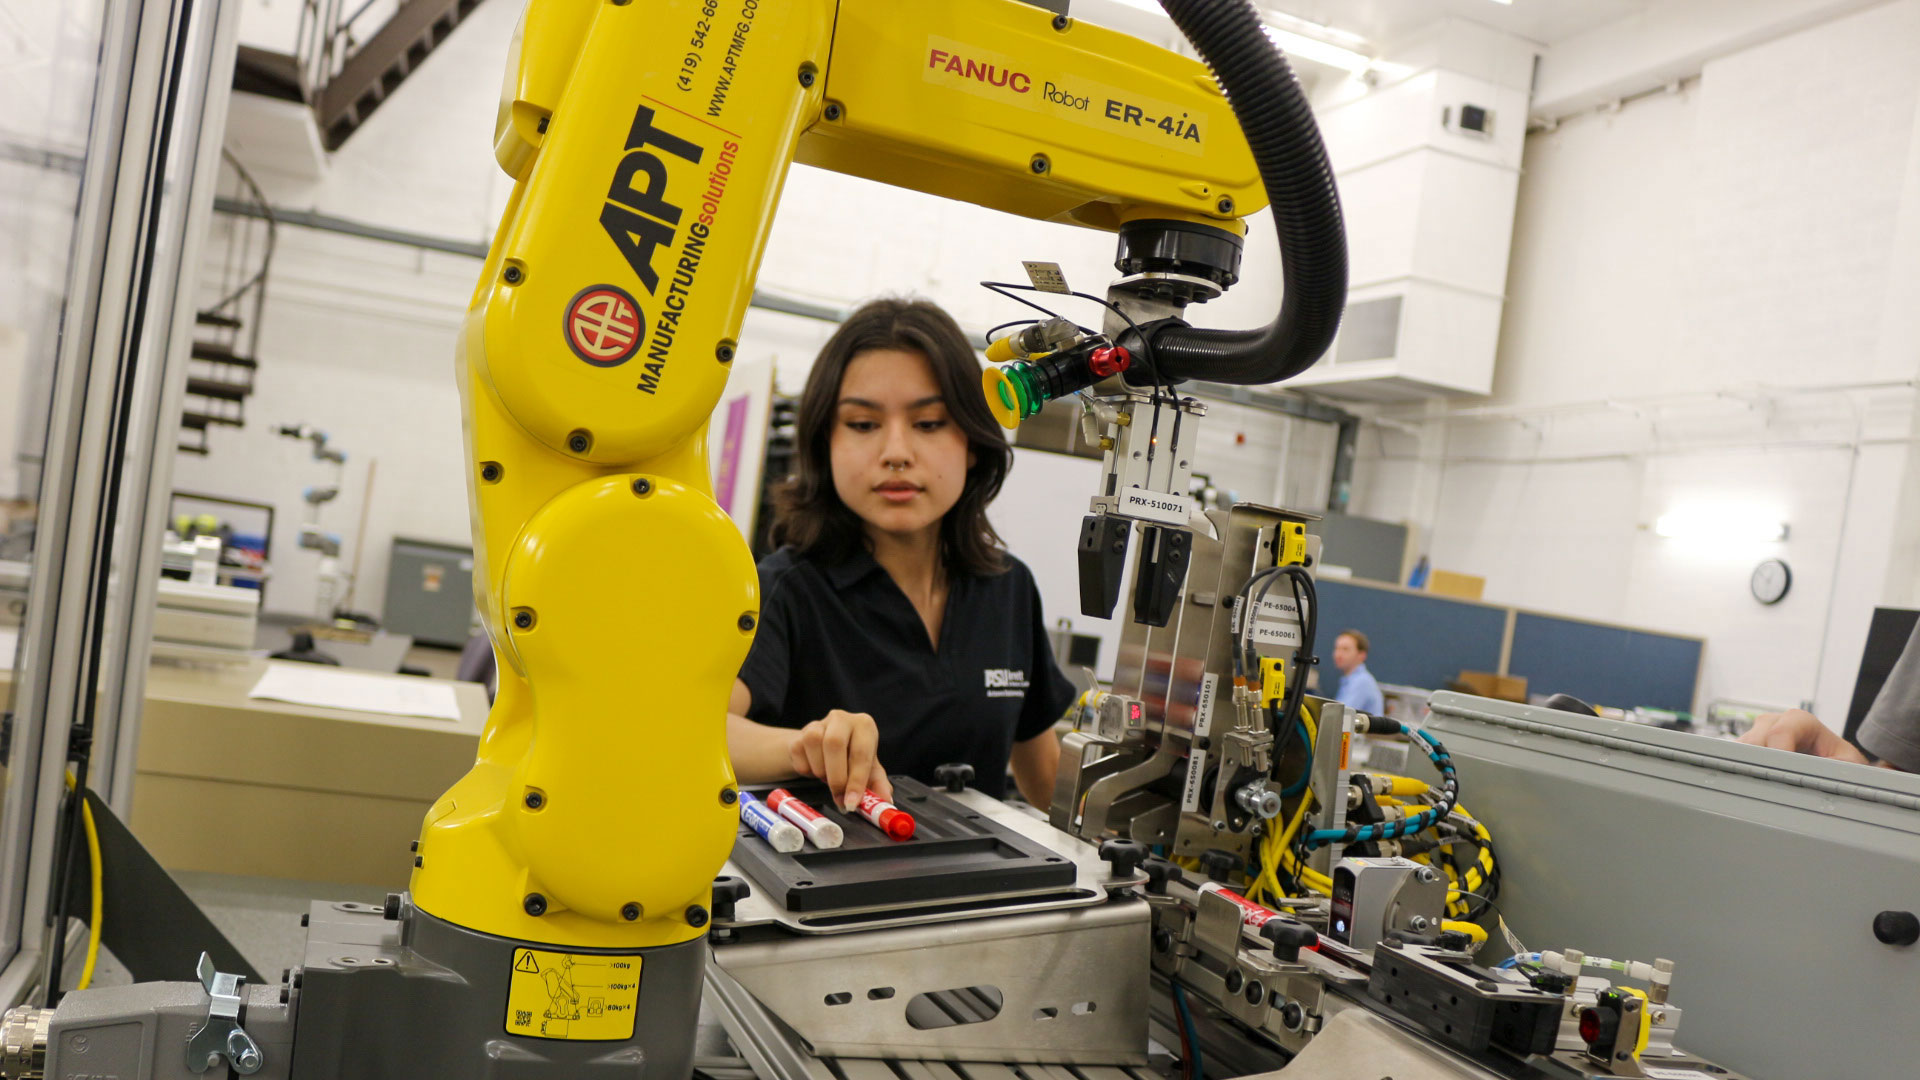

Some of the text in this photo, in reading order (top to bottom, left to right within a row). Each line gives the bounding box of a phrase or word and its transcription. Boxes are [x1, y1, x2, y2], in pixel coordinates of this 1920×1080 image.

[677, 52, 702, 92] (419)
[706, 0, 761, 117] WWW.APTMFG.CO
[929, 48, 1201, 143] FANUC Robot ER-4iA
[599, 103, 704, 297] APT
[1129, 495, 1184, 513] PRX-510071
[1263, 601, 1299, 613] PE-65004
[1259, 628, 1296, 639] PE-650061
[1198, 680, 1212, 728] PRX-650101
